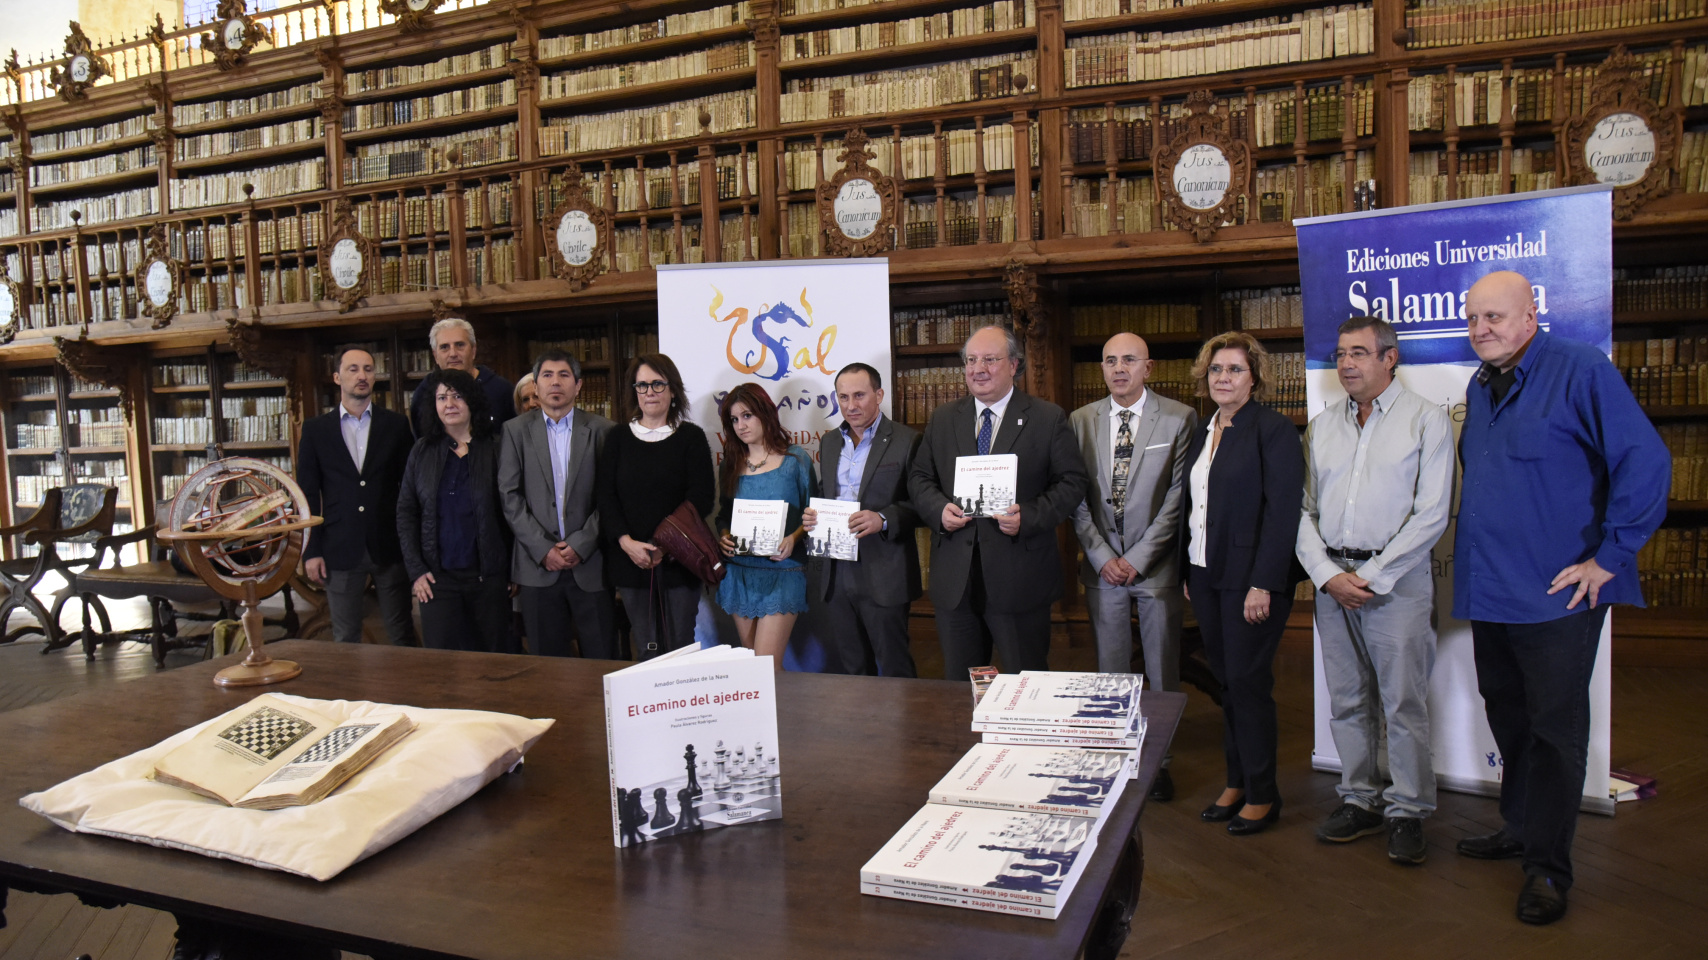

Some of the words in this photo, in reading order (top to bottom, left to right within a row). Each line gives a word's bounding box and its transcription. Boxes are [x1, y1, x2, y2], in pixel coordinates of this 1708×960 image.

[1598, 122, 1634, 140] Jus
[1184, 152, 1213, 168] Jus
[1590, 147, 1654, 168] Canonicum
[842, 187, 866, 202] Jus
[1177, 177, 1229, 194] Canonicum
[837, 208, 881, 224] Canonicum
[1346, 248, 1429, 273] Ediciones
[1434, 230, 1546, 266] Universidad
[1348, 277, 1549, 324] Salamaa
[654, 680, 674, 688] Amador
[628, 706, 639, 717] El
[644, 698, 686, 714] camino
[690, 694, 709, 706] del
[714, 690, 760, 706] ajedrez
[914, 841, 937, 861] camino
[931, 831, 946, 840] del
[940, 812, 963, 830] ajedrez
